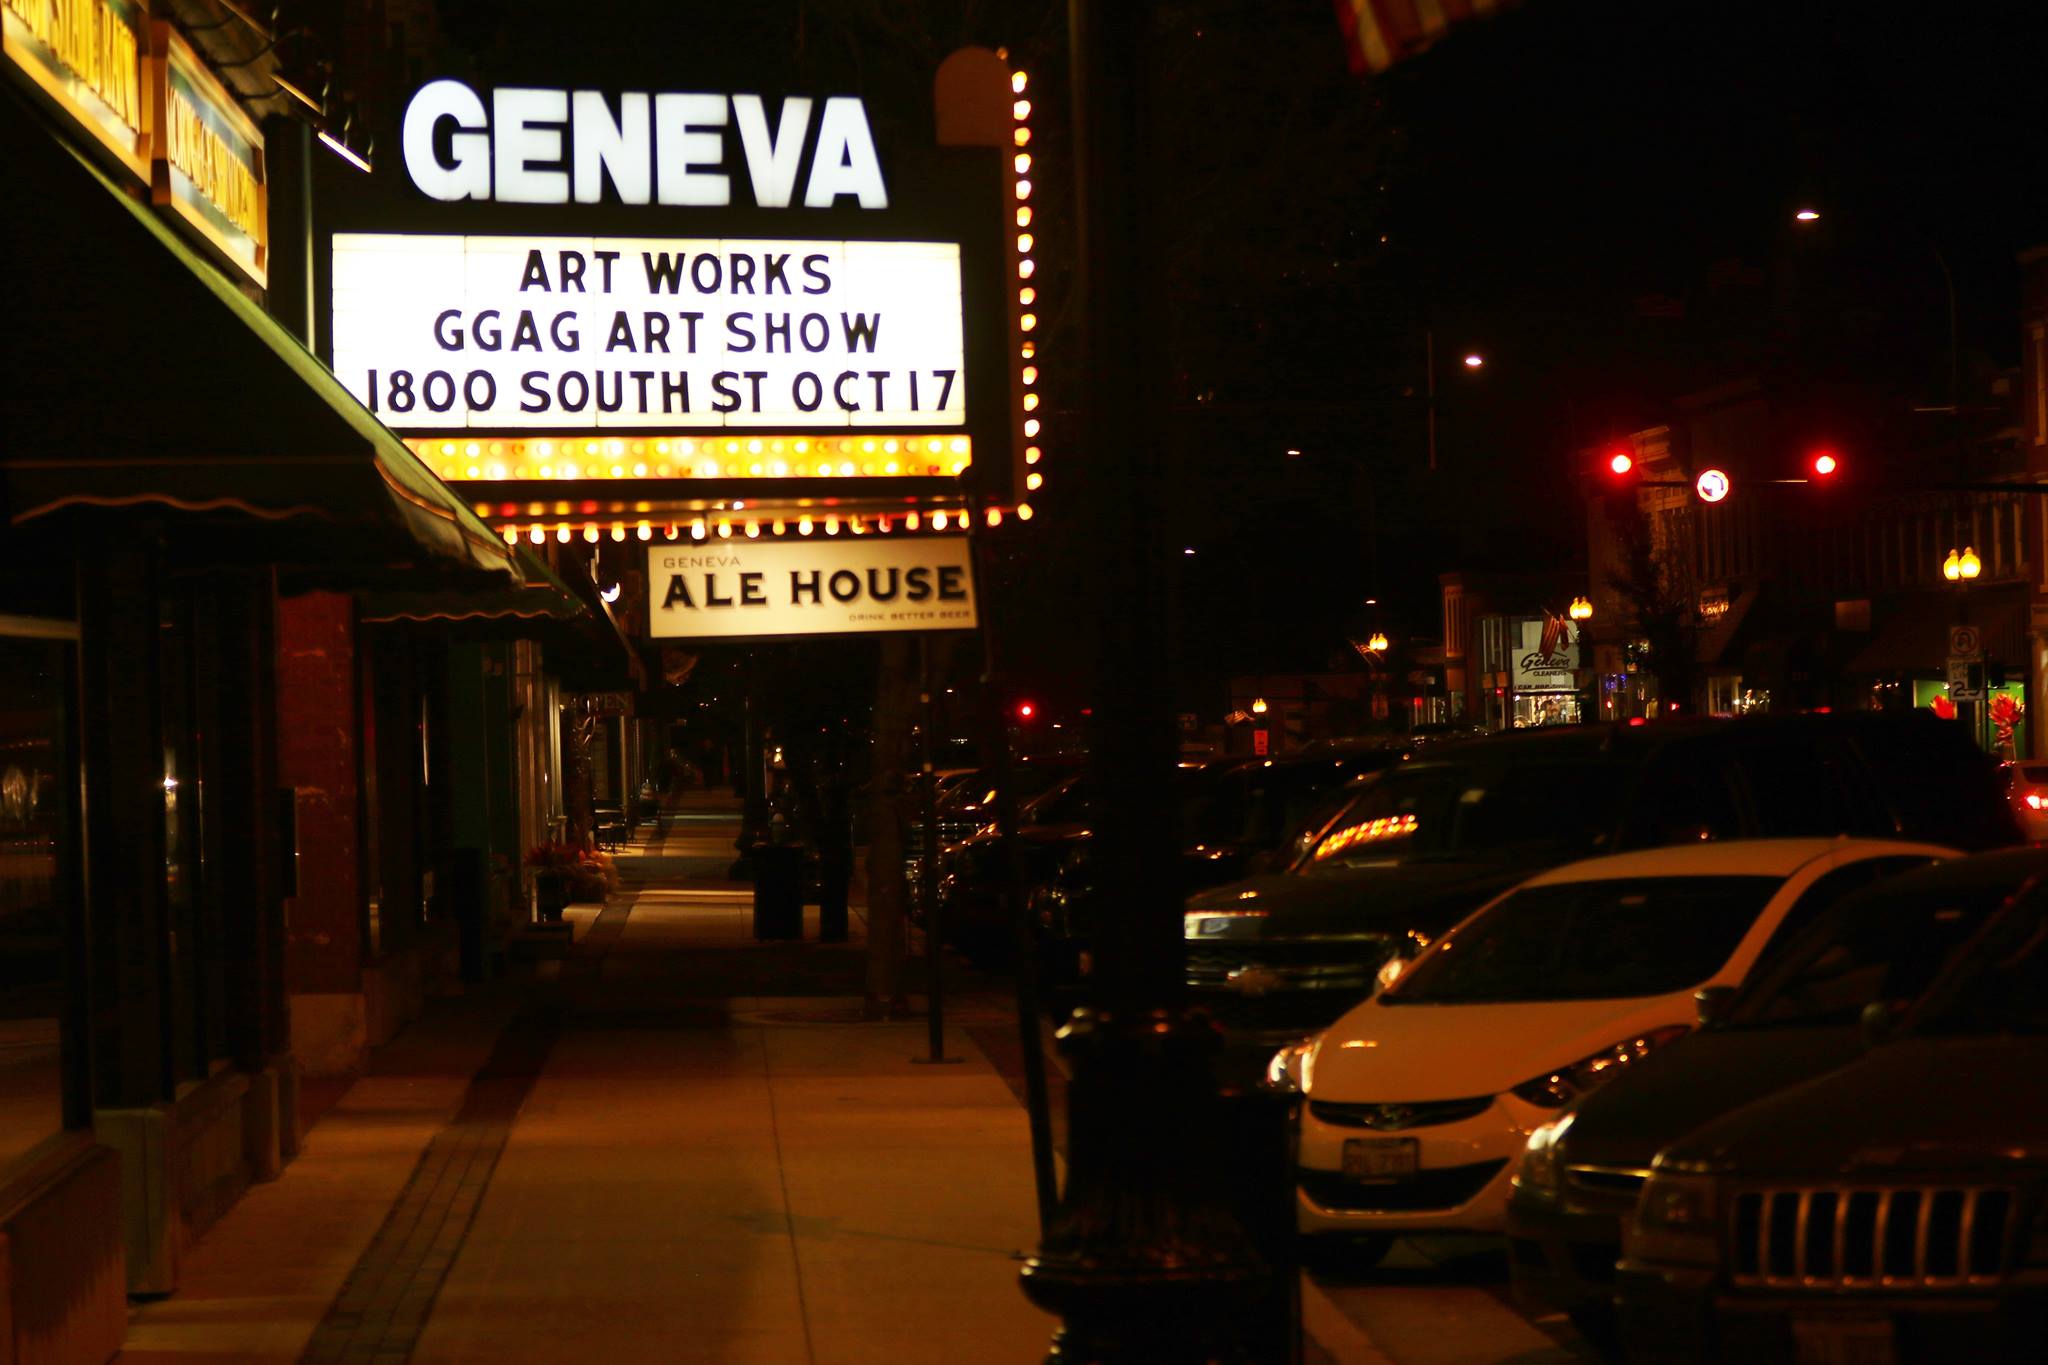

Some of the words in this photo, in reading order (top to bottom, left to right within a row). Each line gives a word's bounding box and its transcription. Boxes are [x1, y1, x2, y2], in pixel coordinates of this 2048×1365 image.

[402, 79, 888, 209] GENEVA
[519, 249, 621, 294] ART
[641, 252, 831, 295] WORKS
[434, 309, 580, 353] GGAG
[605, 311, 704, 354] ART
[726, 311, 881, 354] SHOW
[367, 370, 497, 413] 1800
[520, 370, 690, 414] SOUTH
[711, 371, 768, 414] ST
[792, 371, 891, 413] OCT
[910, 370, 957, 412] 17
[663, 556, 742, 569] GENEVA
[661, 572, 768, 610] ALE
[790, 565, 968, 605] HOUSE
[848, 613, 884, 622] DRINK
[890, 611, 934, 621] BETTER
[939, 610, 970, 620] BEER
[1520, 652, 1570, 672] Geneva
